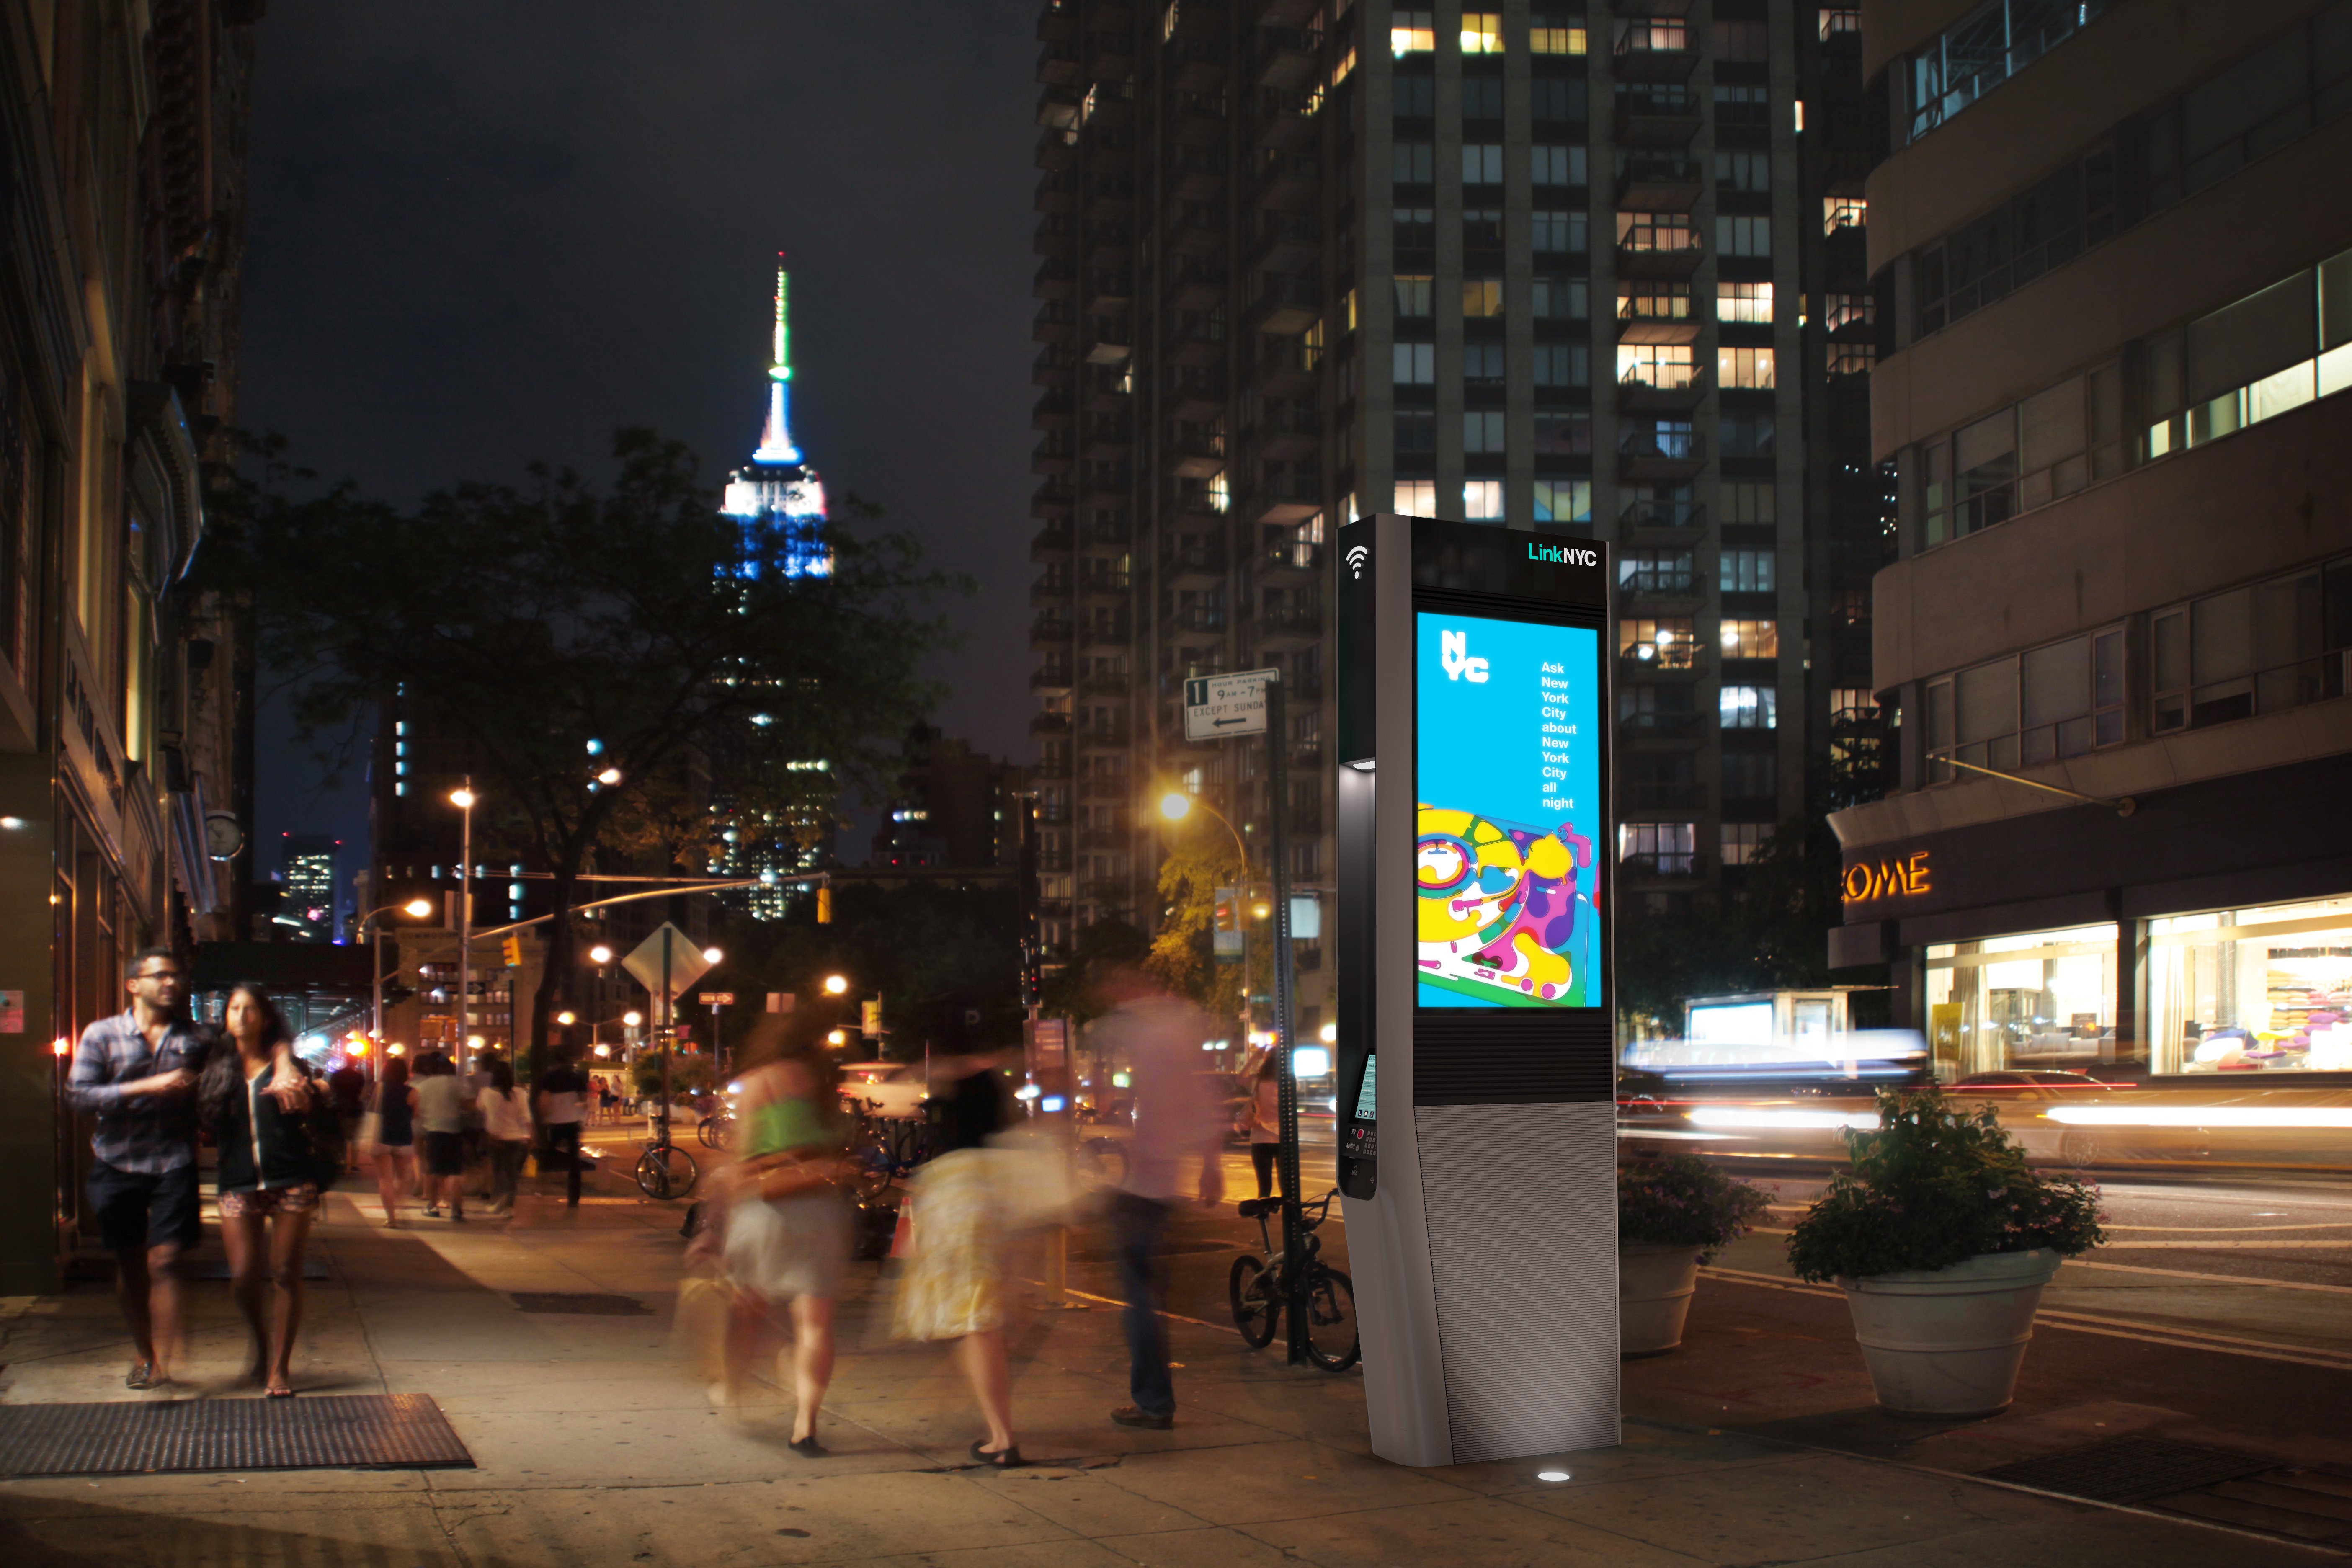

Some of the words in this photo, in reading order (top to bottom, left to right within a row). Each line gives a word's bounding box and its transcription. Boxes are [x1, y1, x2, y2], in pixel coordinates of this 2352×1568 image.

[1528, 542, 1596, 567] LinkNYC
[1441, 630, 1489, 683] NYC
[1541, 662, 1564, 674] Ask
[1237, 676, 1271, 685] PARKING
[1542, 676, 1568, 689] New
[1194, 682, 1200, 704] 1
[1542, 691, 1569, 704] York
[1194, 705, 1227, 717] EXCEPT
[1234, 701, 1266, 712] SUNDA
[1542, 707, 1566, 721] City
[1542, 722, 1577, 734] about
[1542, 736, 1569, 748] New
[1542, 751, 1569, 763] York
[1542, 766, 1567, 780] City
[1542, 782, 1556, 792] all
[1542, 797, 1574, 810] night
[1841, 852, 1929, 902] OME
